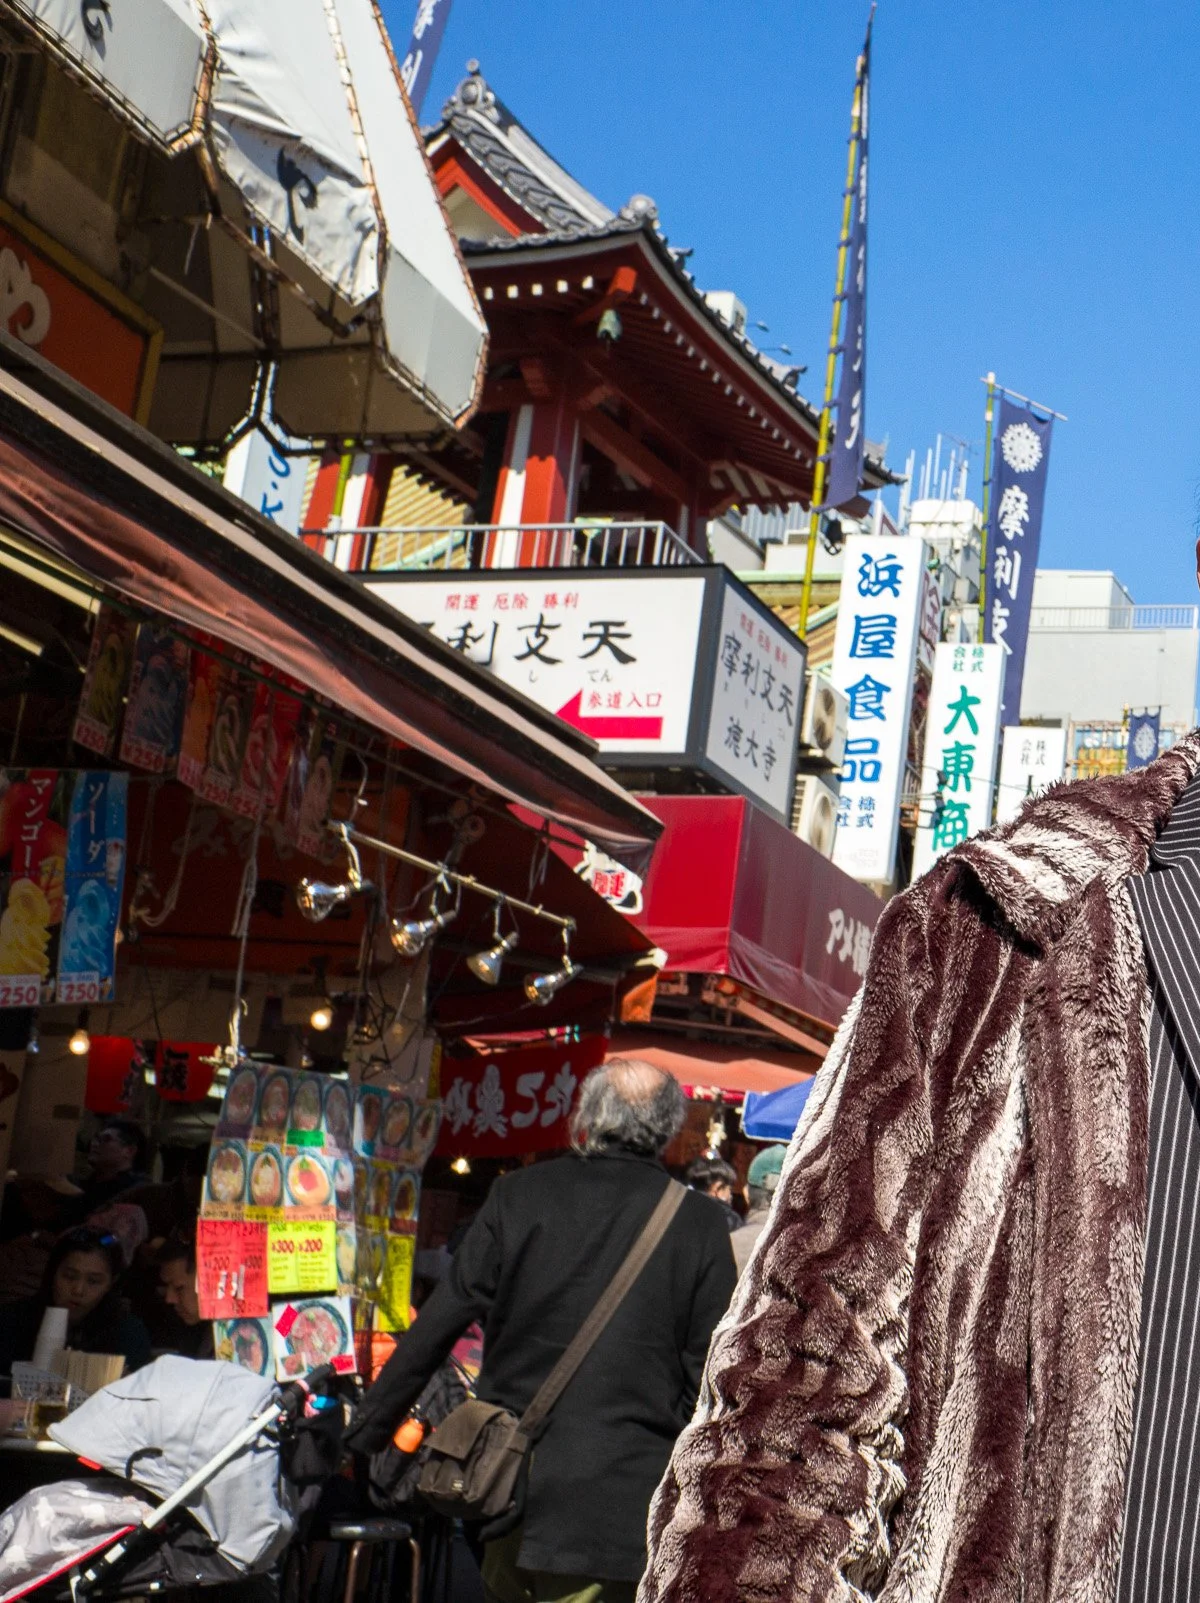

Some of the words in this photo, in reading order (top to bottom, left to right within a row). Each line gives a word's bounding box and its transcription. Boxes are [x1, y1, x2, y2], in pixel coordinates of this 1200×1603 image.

[992, 484, 1030, 656] 摩利支
[414, 612, 638, 666] 利支天
[721, 632, 794, 728] 摩利支天
[838, 552, 904, 784] 浜屋食品
[587, 692, 663, 709] 参道入口
[20, 776, 53, 868] マンゴー
[86, 781, 106, 864] ソーダ
